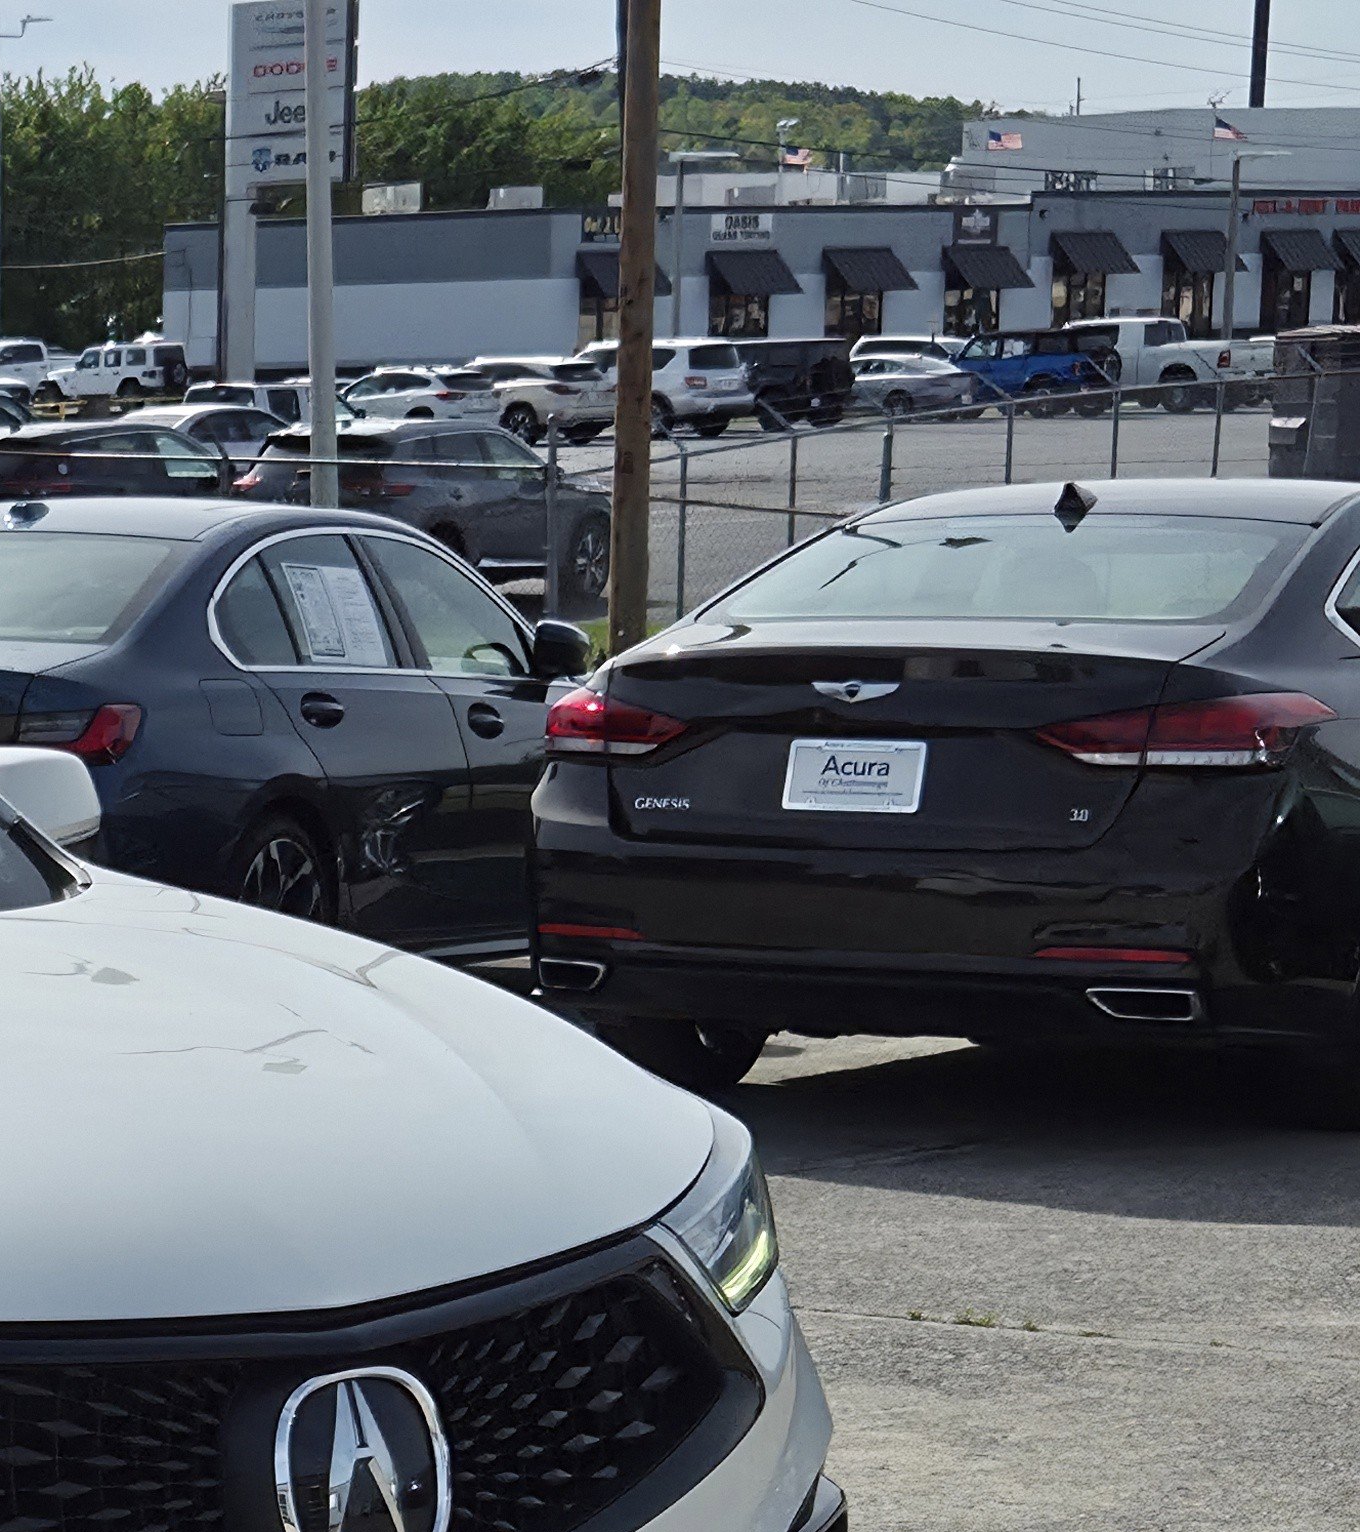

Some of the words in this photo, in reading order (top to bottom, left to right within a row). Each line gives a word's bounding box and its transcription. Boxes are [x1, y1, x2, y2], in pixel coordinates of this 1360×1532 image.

[253, 57, 337, 78] DODE
[264, 100, 306, 127] Jee
[274, 150, 336, 166] RA
[821, 755, 890, 776] Acura
[634, 797, 690, 810] GENESIS
